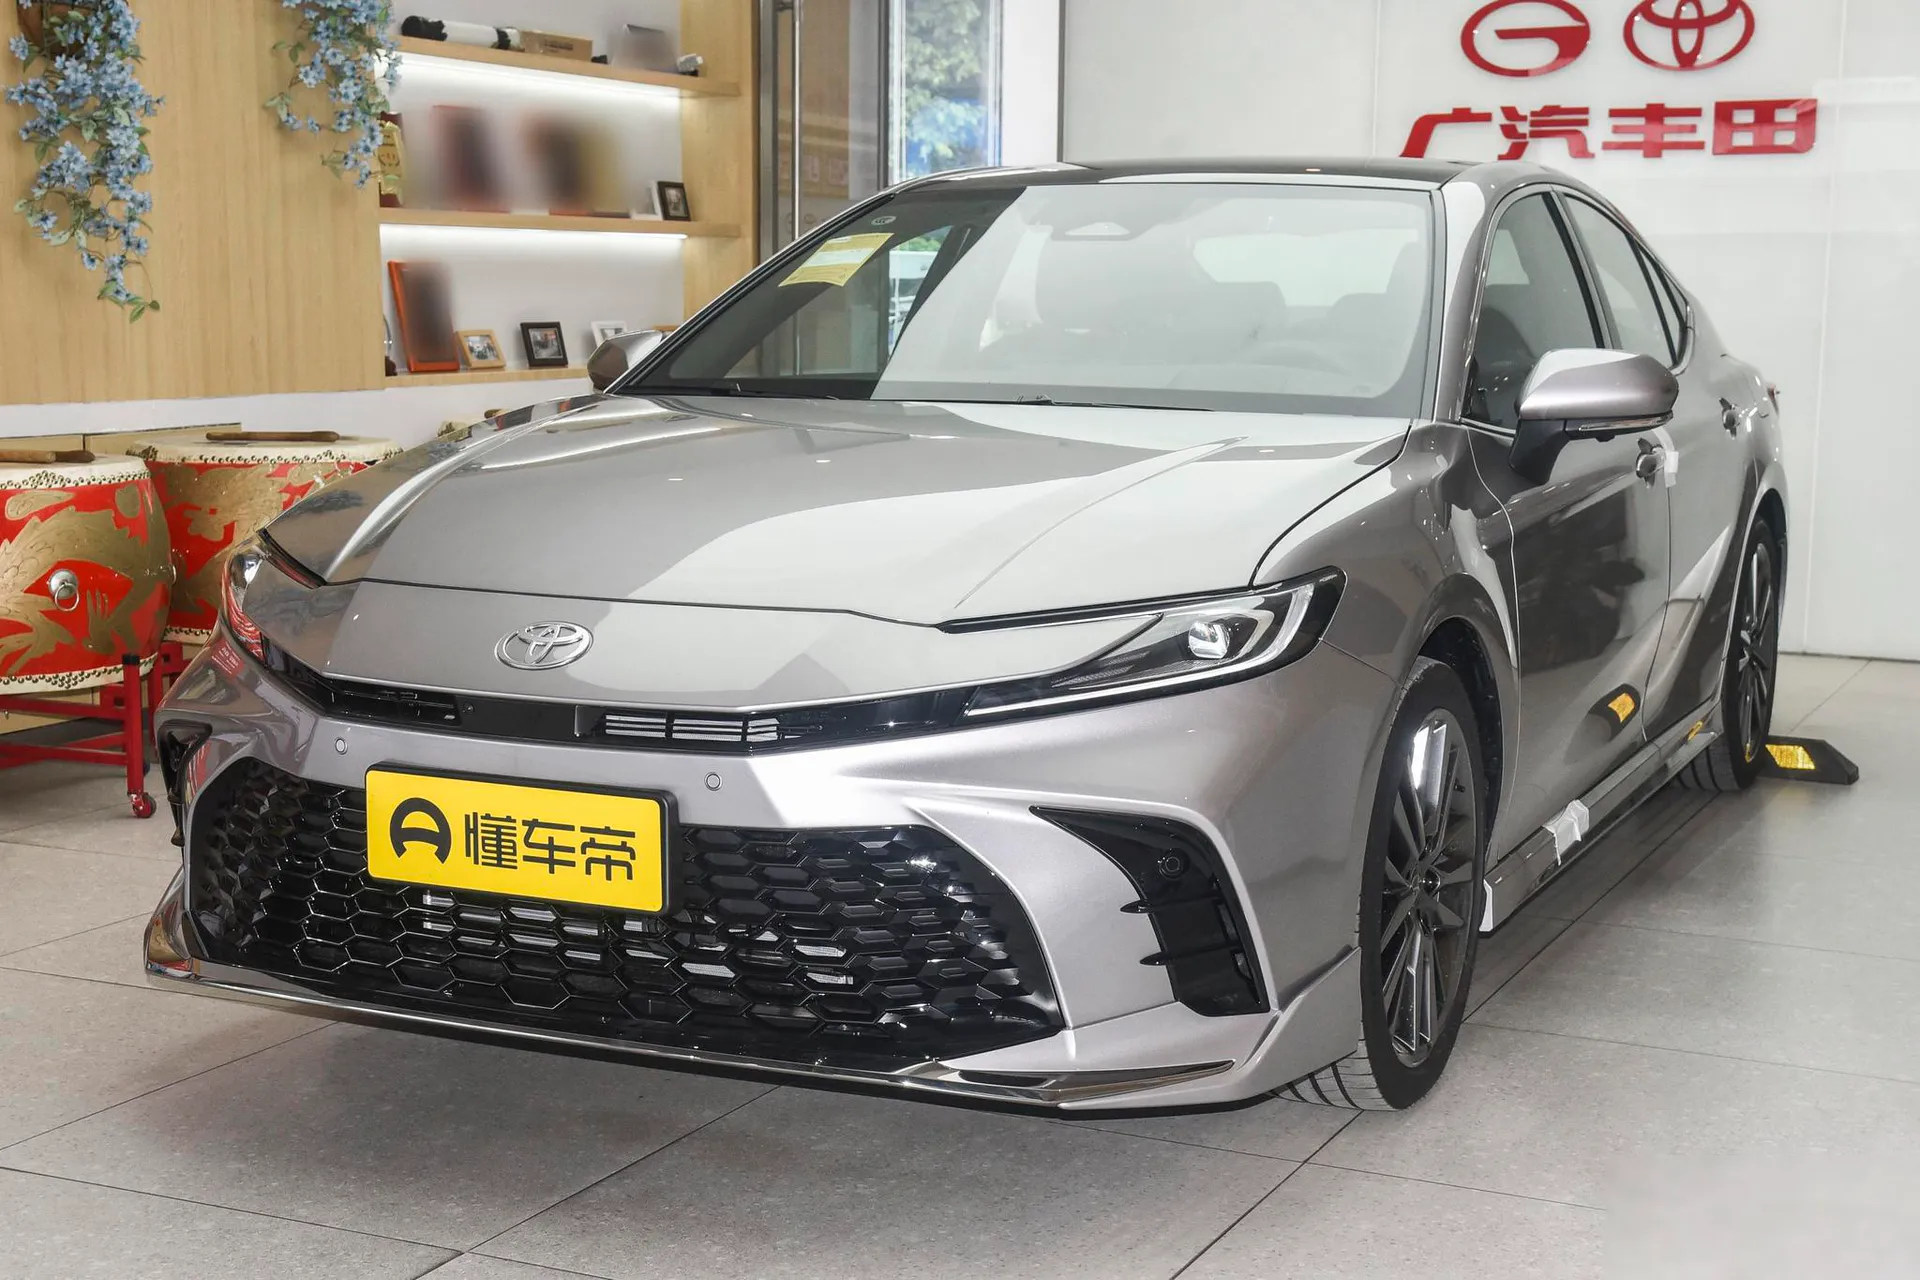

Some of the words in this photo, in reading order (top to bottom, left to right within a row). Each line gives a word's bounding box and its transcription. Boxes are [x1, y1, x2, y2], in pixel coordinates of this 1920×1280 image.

[1400, 98, 1818, 161] 广汽丰田
[464, 811, 636, 881] 懂车帝
